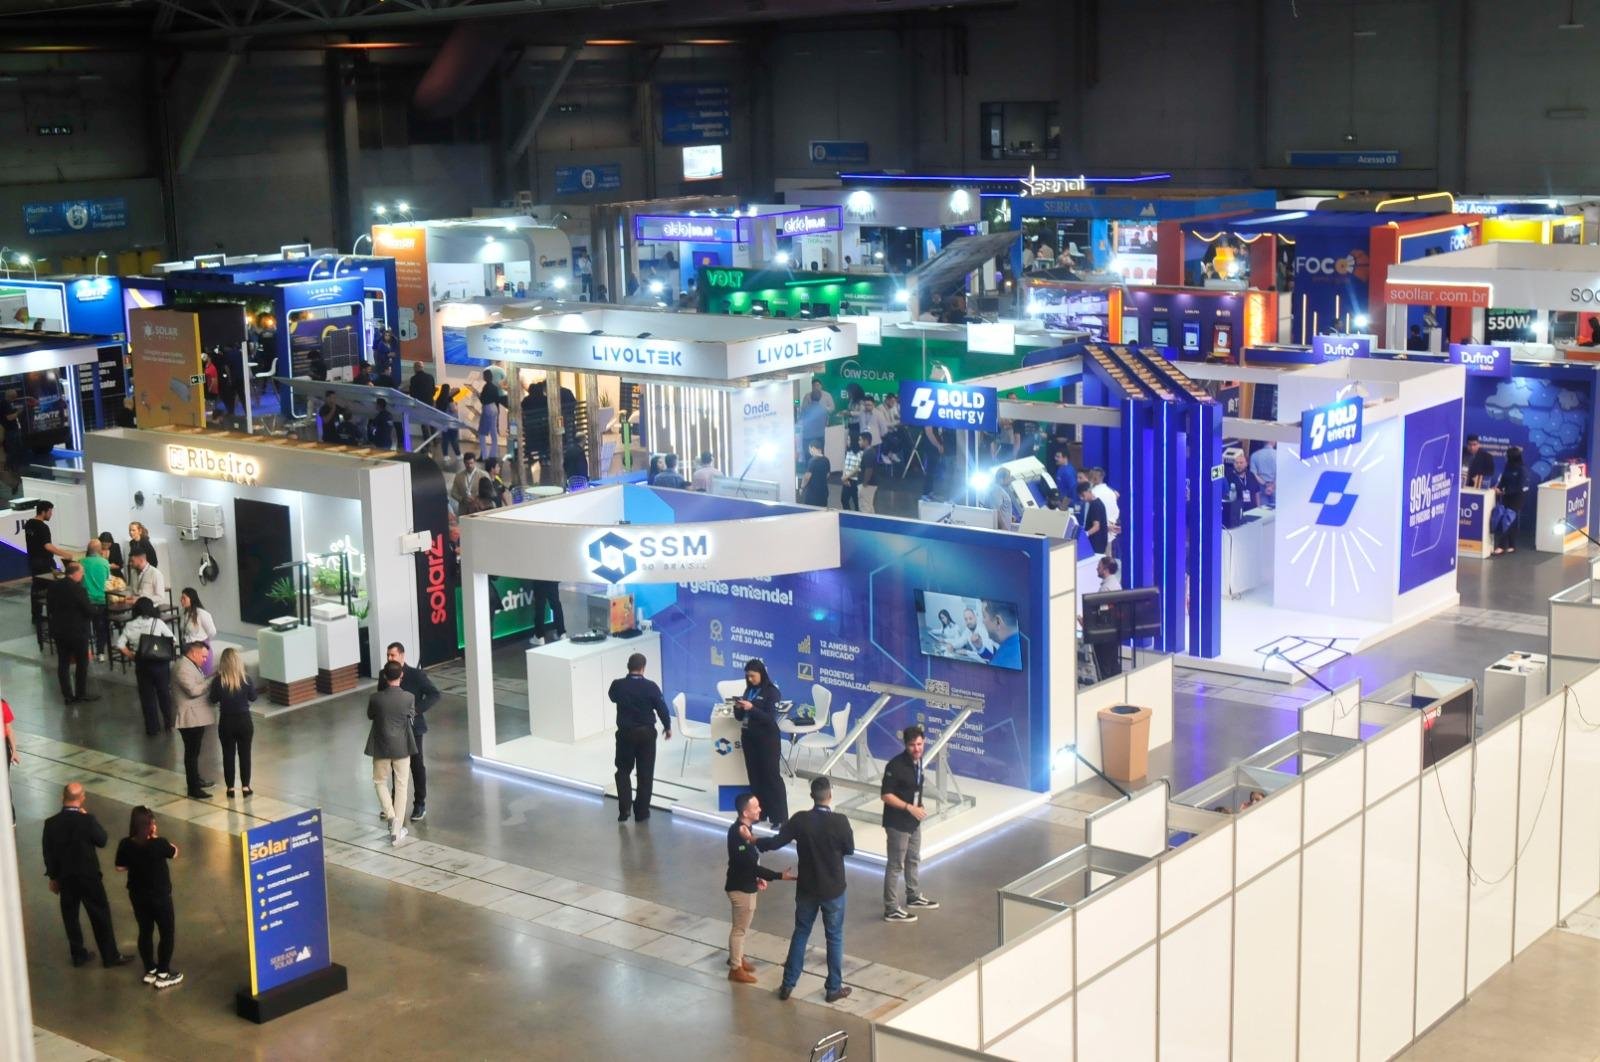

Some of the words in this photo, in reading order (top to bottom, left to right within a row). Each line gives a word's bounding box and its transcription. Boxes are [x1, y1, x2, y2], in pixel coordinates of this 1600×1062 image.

[1358, 155, 1384, 165] Acesso
[1386, 155, 1397, 165] 03
[706, 270, 744, 288] VOLT
[1488, 316, 1531, 331] 550W
[592, 346, 683, 367] LIVOLTEK
[757, 336, 833, 364] LIVOLTEK
[743, 401, 770, 416] Onde
[937, 388, 985, 410] BOLD
[938, 405, 985, 425] energy
[1327, 423, 1357, 442] energy
[186, 448, 255, 476] Ribeiro
[1410, 473, 1431, 513] 99%
[639, 535, 708, 557] SSM
[690, 580, 729, 596] gente
[731, 584, 793, 606] entende!
[730, 626, 764, 639] GARANTIA
[764, 632, 775, 641] DE
[753, 638, 773, 648] ANOS
[819, 640, 827, 648] 12
[828, 642, 849, 653] ANOS
[819, 648, 855, 662] MERCADO
[819, 667, 855, 681] PROJETOS
[250, 837, 289, 862] solar
